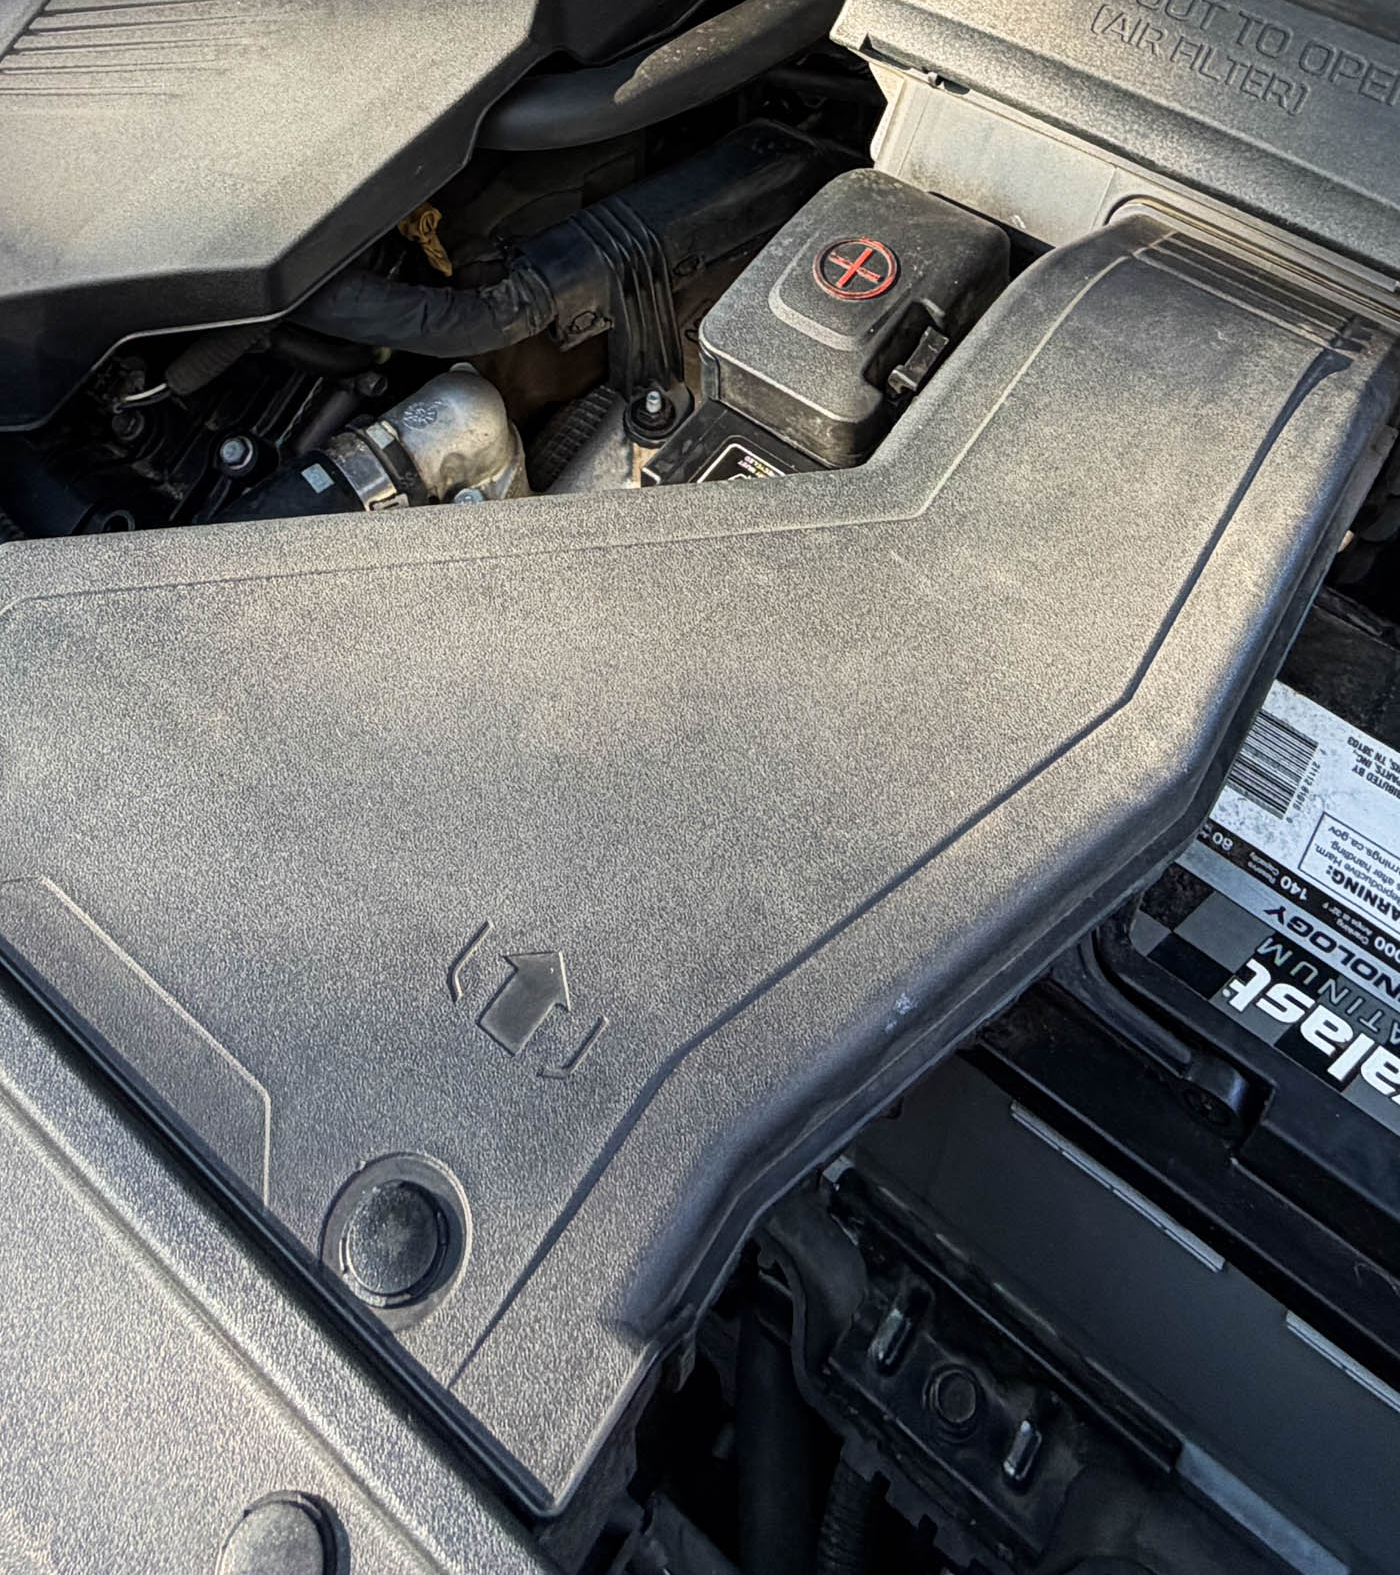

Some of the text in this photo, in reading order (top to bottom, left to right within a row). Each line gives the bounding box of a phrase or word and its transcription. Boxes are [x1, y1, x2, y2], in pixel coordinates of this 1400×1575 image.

[1237, 10, 1296, 59] TO
[1090, 3, 1312, 117] (AIR FILTER)
[1351, 764, 1365, 776] BY
[1373, 751, 1386, 764] TN
[1210, 829, 1234, 851] 80
[1313, 843, 1343, 867] Harm.
[1328, 838, 1371, 872] handling.
[1277, 874, 1310, 901] 140
[1372, 868, 1394, 887] after
[1335, 918, 1369, 945] Cranking
